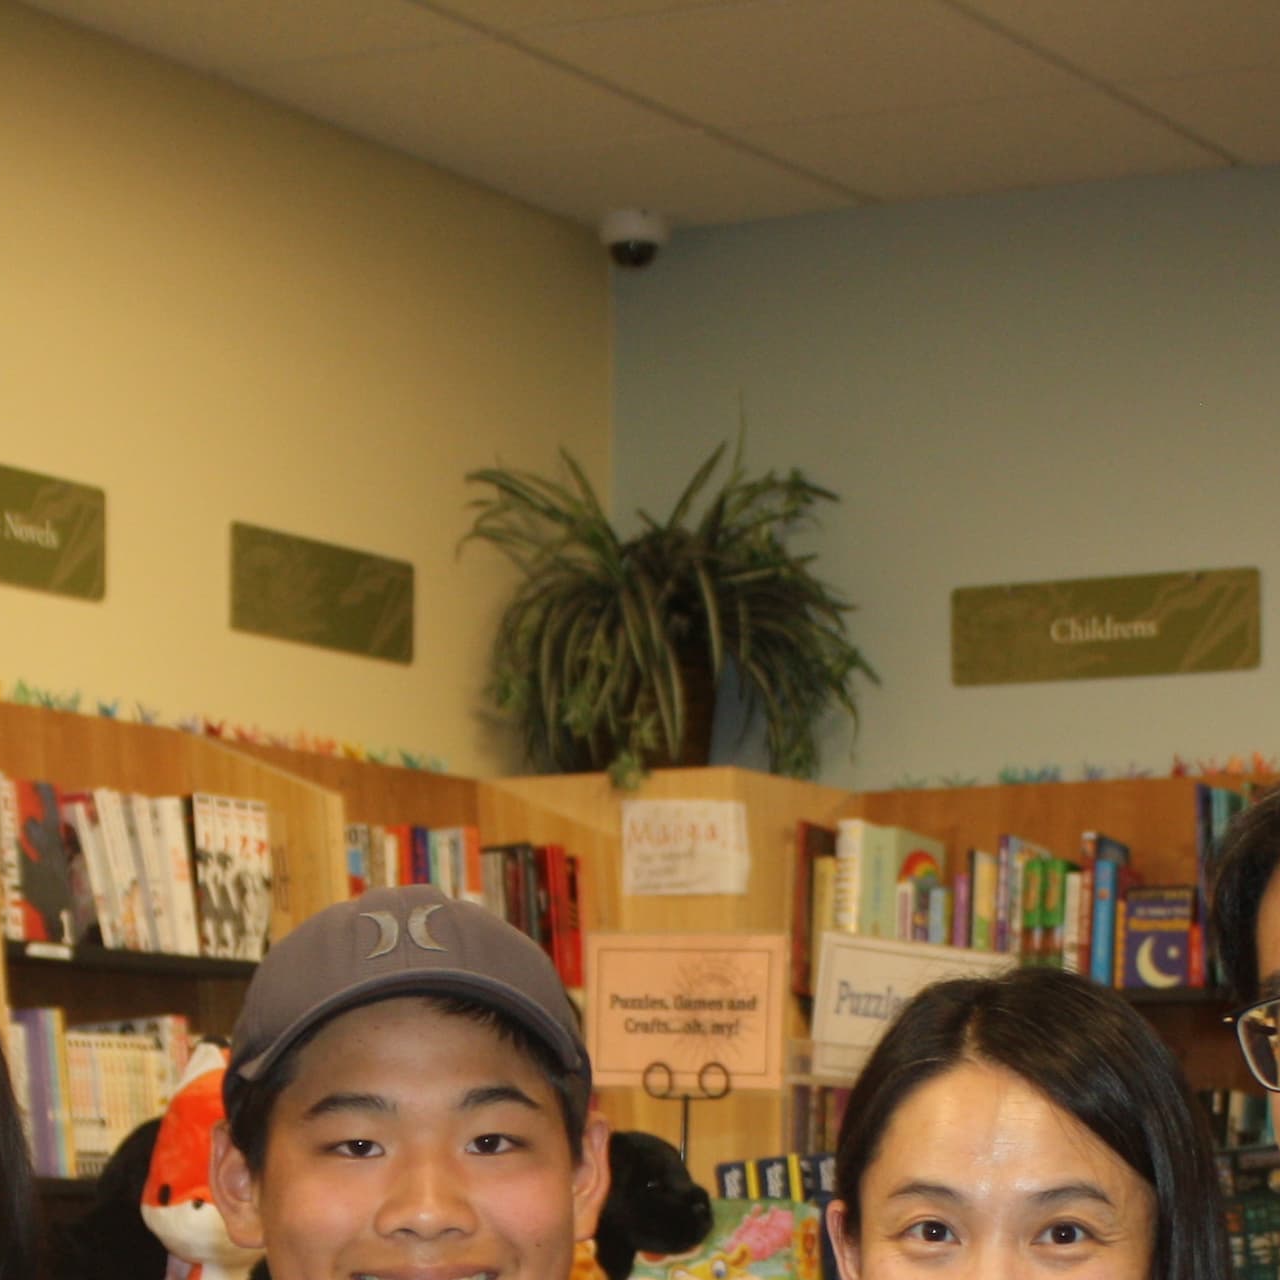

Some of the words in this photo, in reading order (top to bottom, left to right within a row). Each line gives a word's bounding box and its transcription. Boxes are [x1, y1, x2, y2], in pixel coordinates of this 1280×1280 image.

[4, 511, 59, 550] Novels
[1050, 614, 1158, 646] Childrens
[727, 994, 757, 1010] and
[833, 980, 909, 1020] Puzzle
